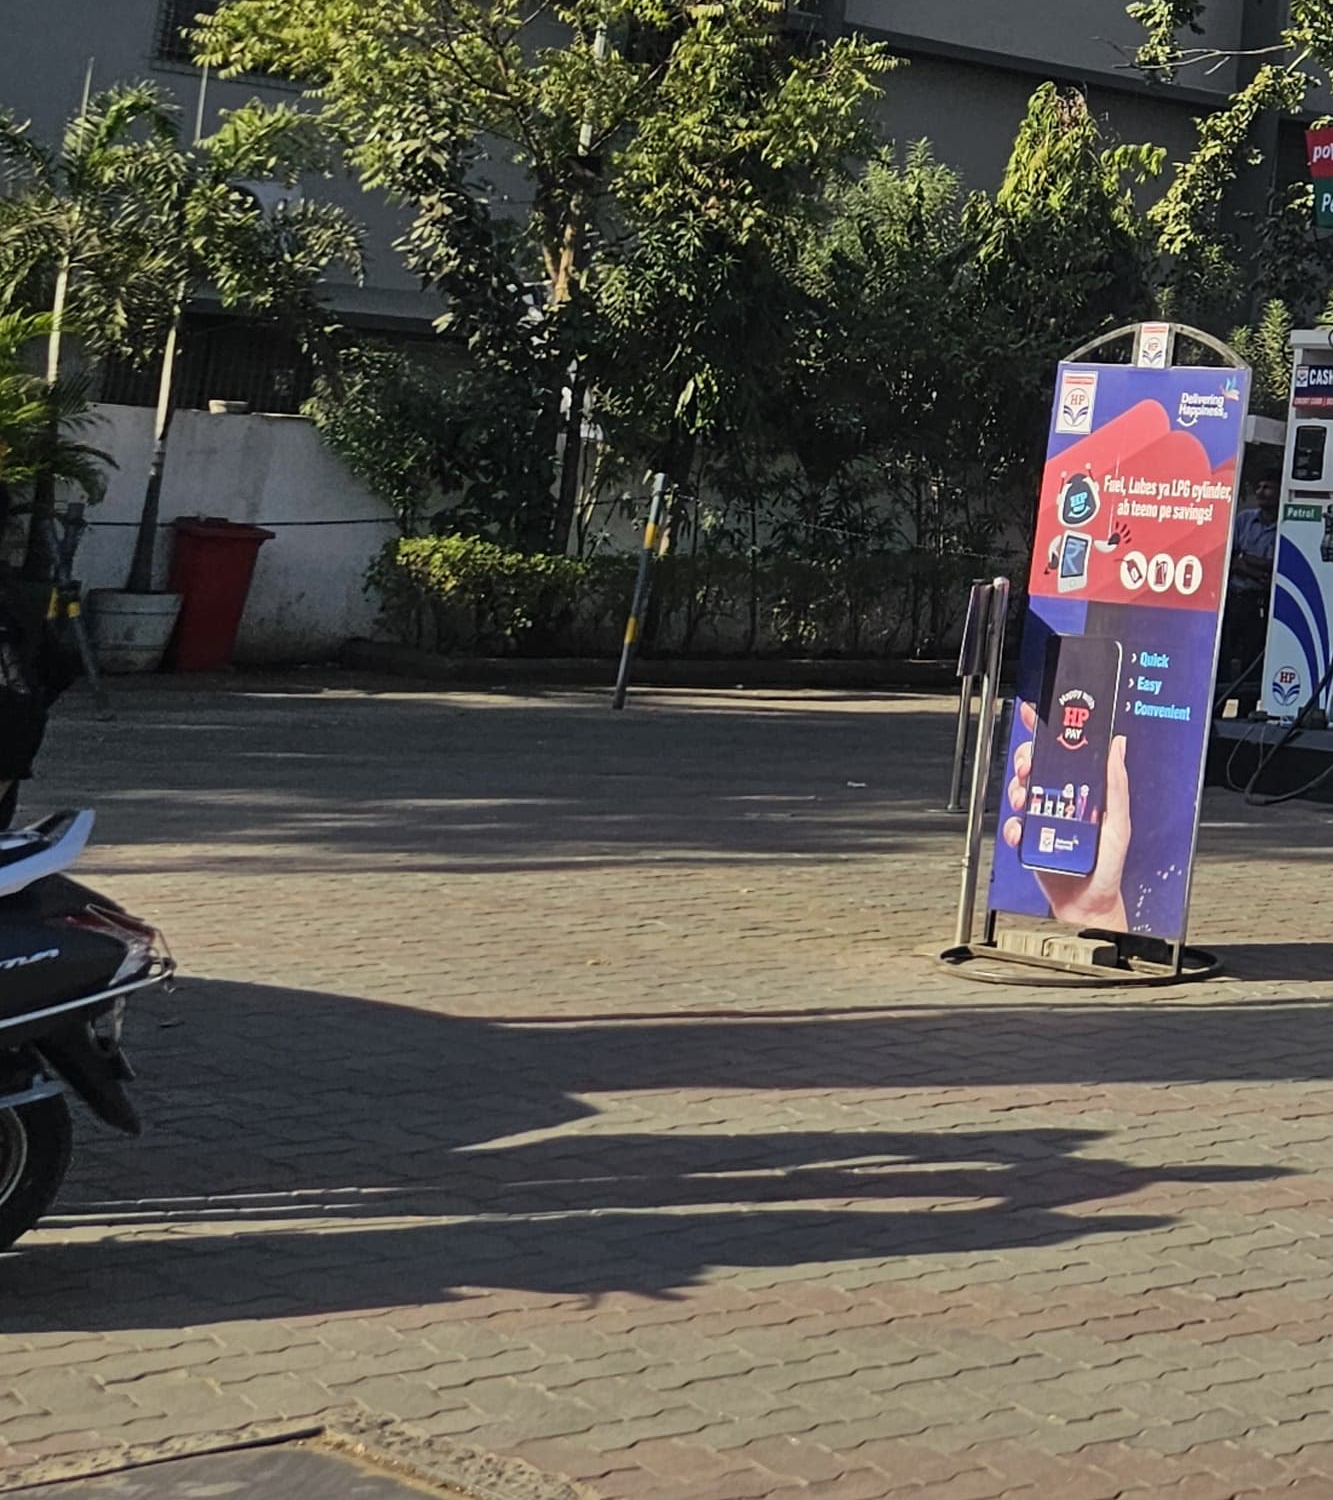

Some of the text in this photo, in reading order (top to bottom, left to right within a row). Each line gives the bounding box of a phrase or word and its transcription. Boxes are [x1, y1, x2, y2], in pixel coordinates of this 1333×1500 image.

[1070, 394, 1085, 405] HP
[1181, 393, 1224, 407] Delivering
[1104, 475, 1232, 503] Fuel, Lubes ya LPG cylinder,
[1117, 499, 1213, 525] ab teeno pe savings!
[1287, 507, 1315, 518] Petrol
[1139, 652, 1169, 669] Quick
[1136, 676, 1162, 695] Easy
[1280, 671, 1296, 684] HP
[1063, 706, 1090, 727] HP
[1134, 700, 1191, 721] Convenient
[1065, 727, 1083, 740] PAY
